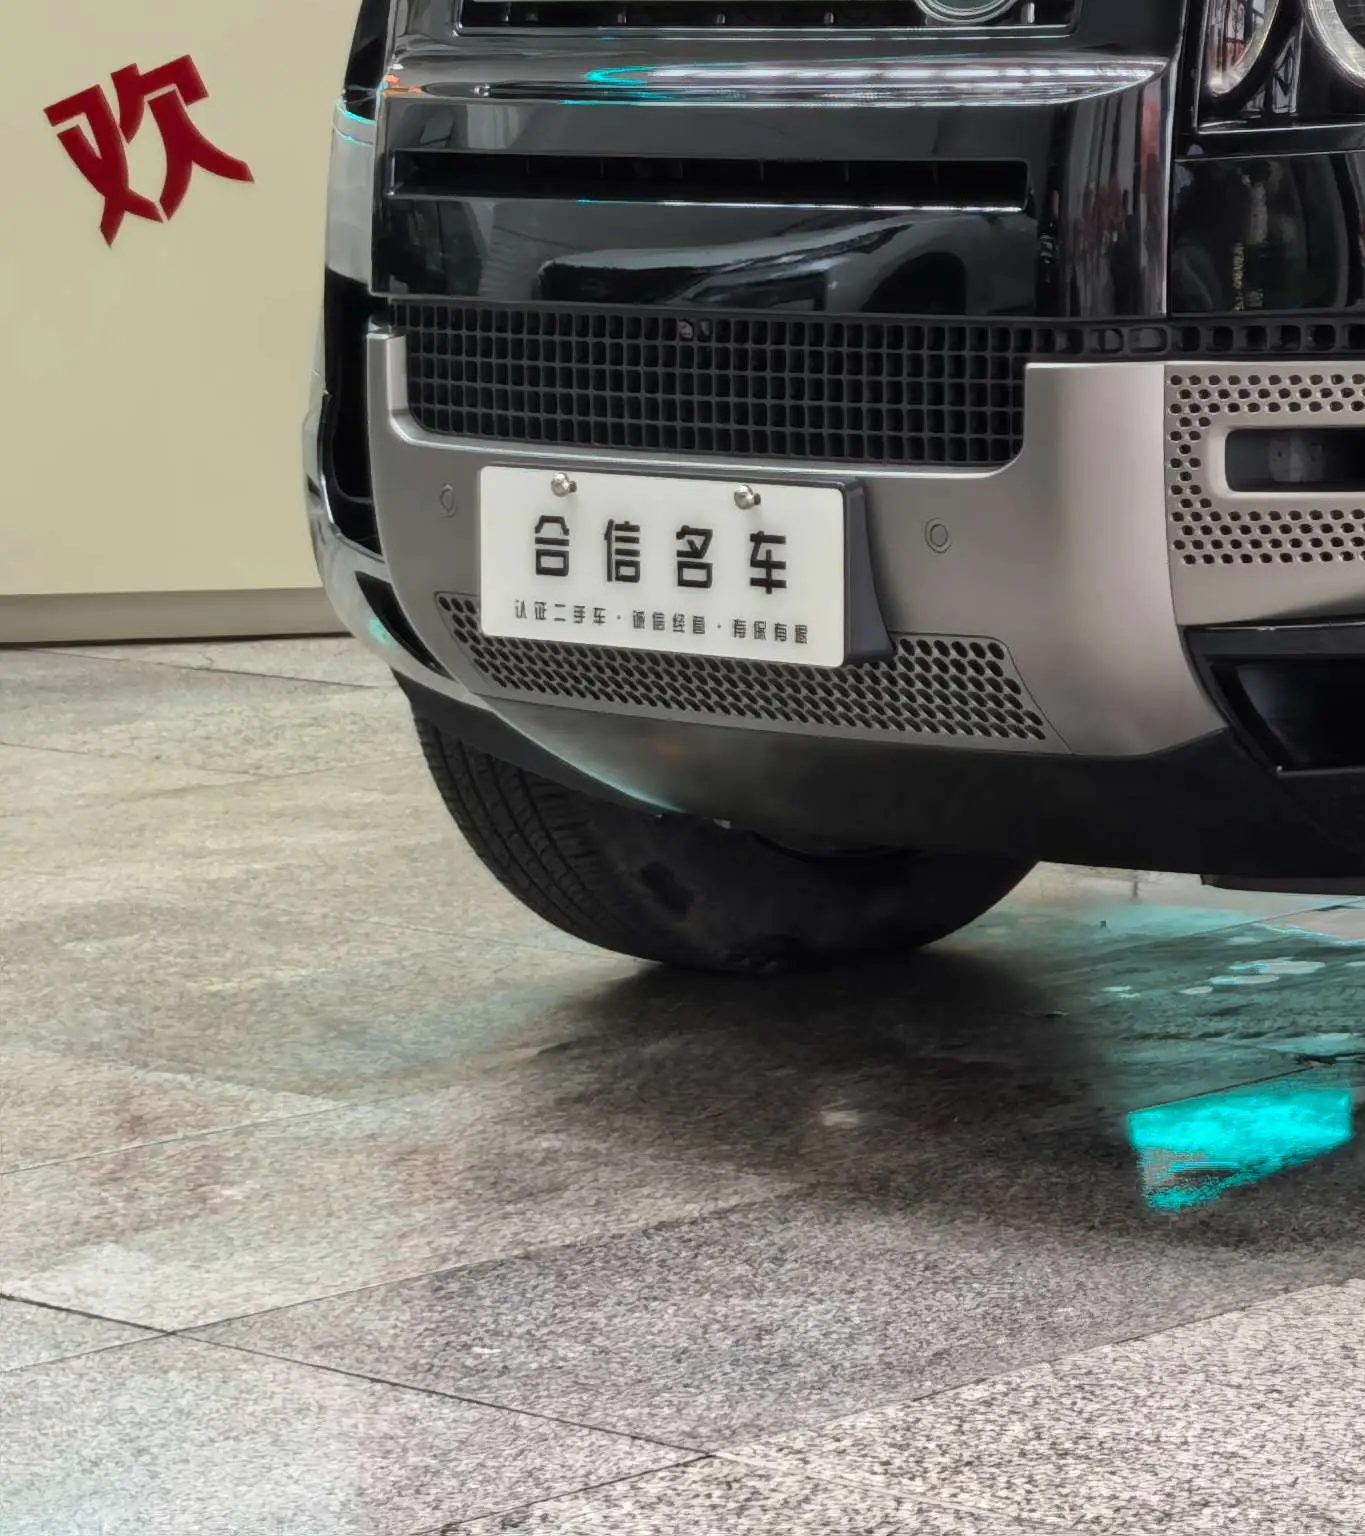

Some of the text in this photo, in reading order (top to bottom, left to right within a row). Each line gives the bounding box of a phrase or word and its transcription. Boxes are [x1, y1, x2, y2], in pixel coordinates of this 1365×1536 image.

[43, 54, 255, 248] 欢
[534, 513, 788, 595] 合信名车
